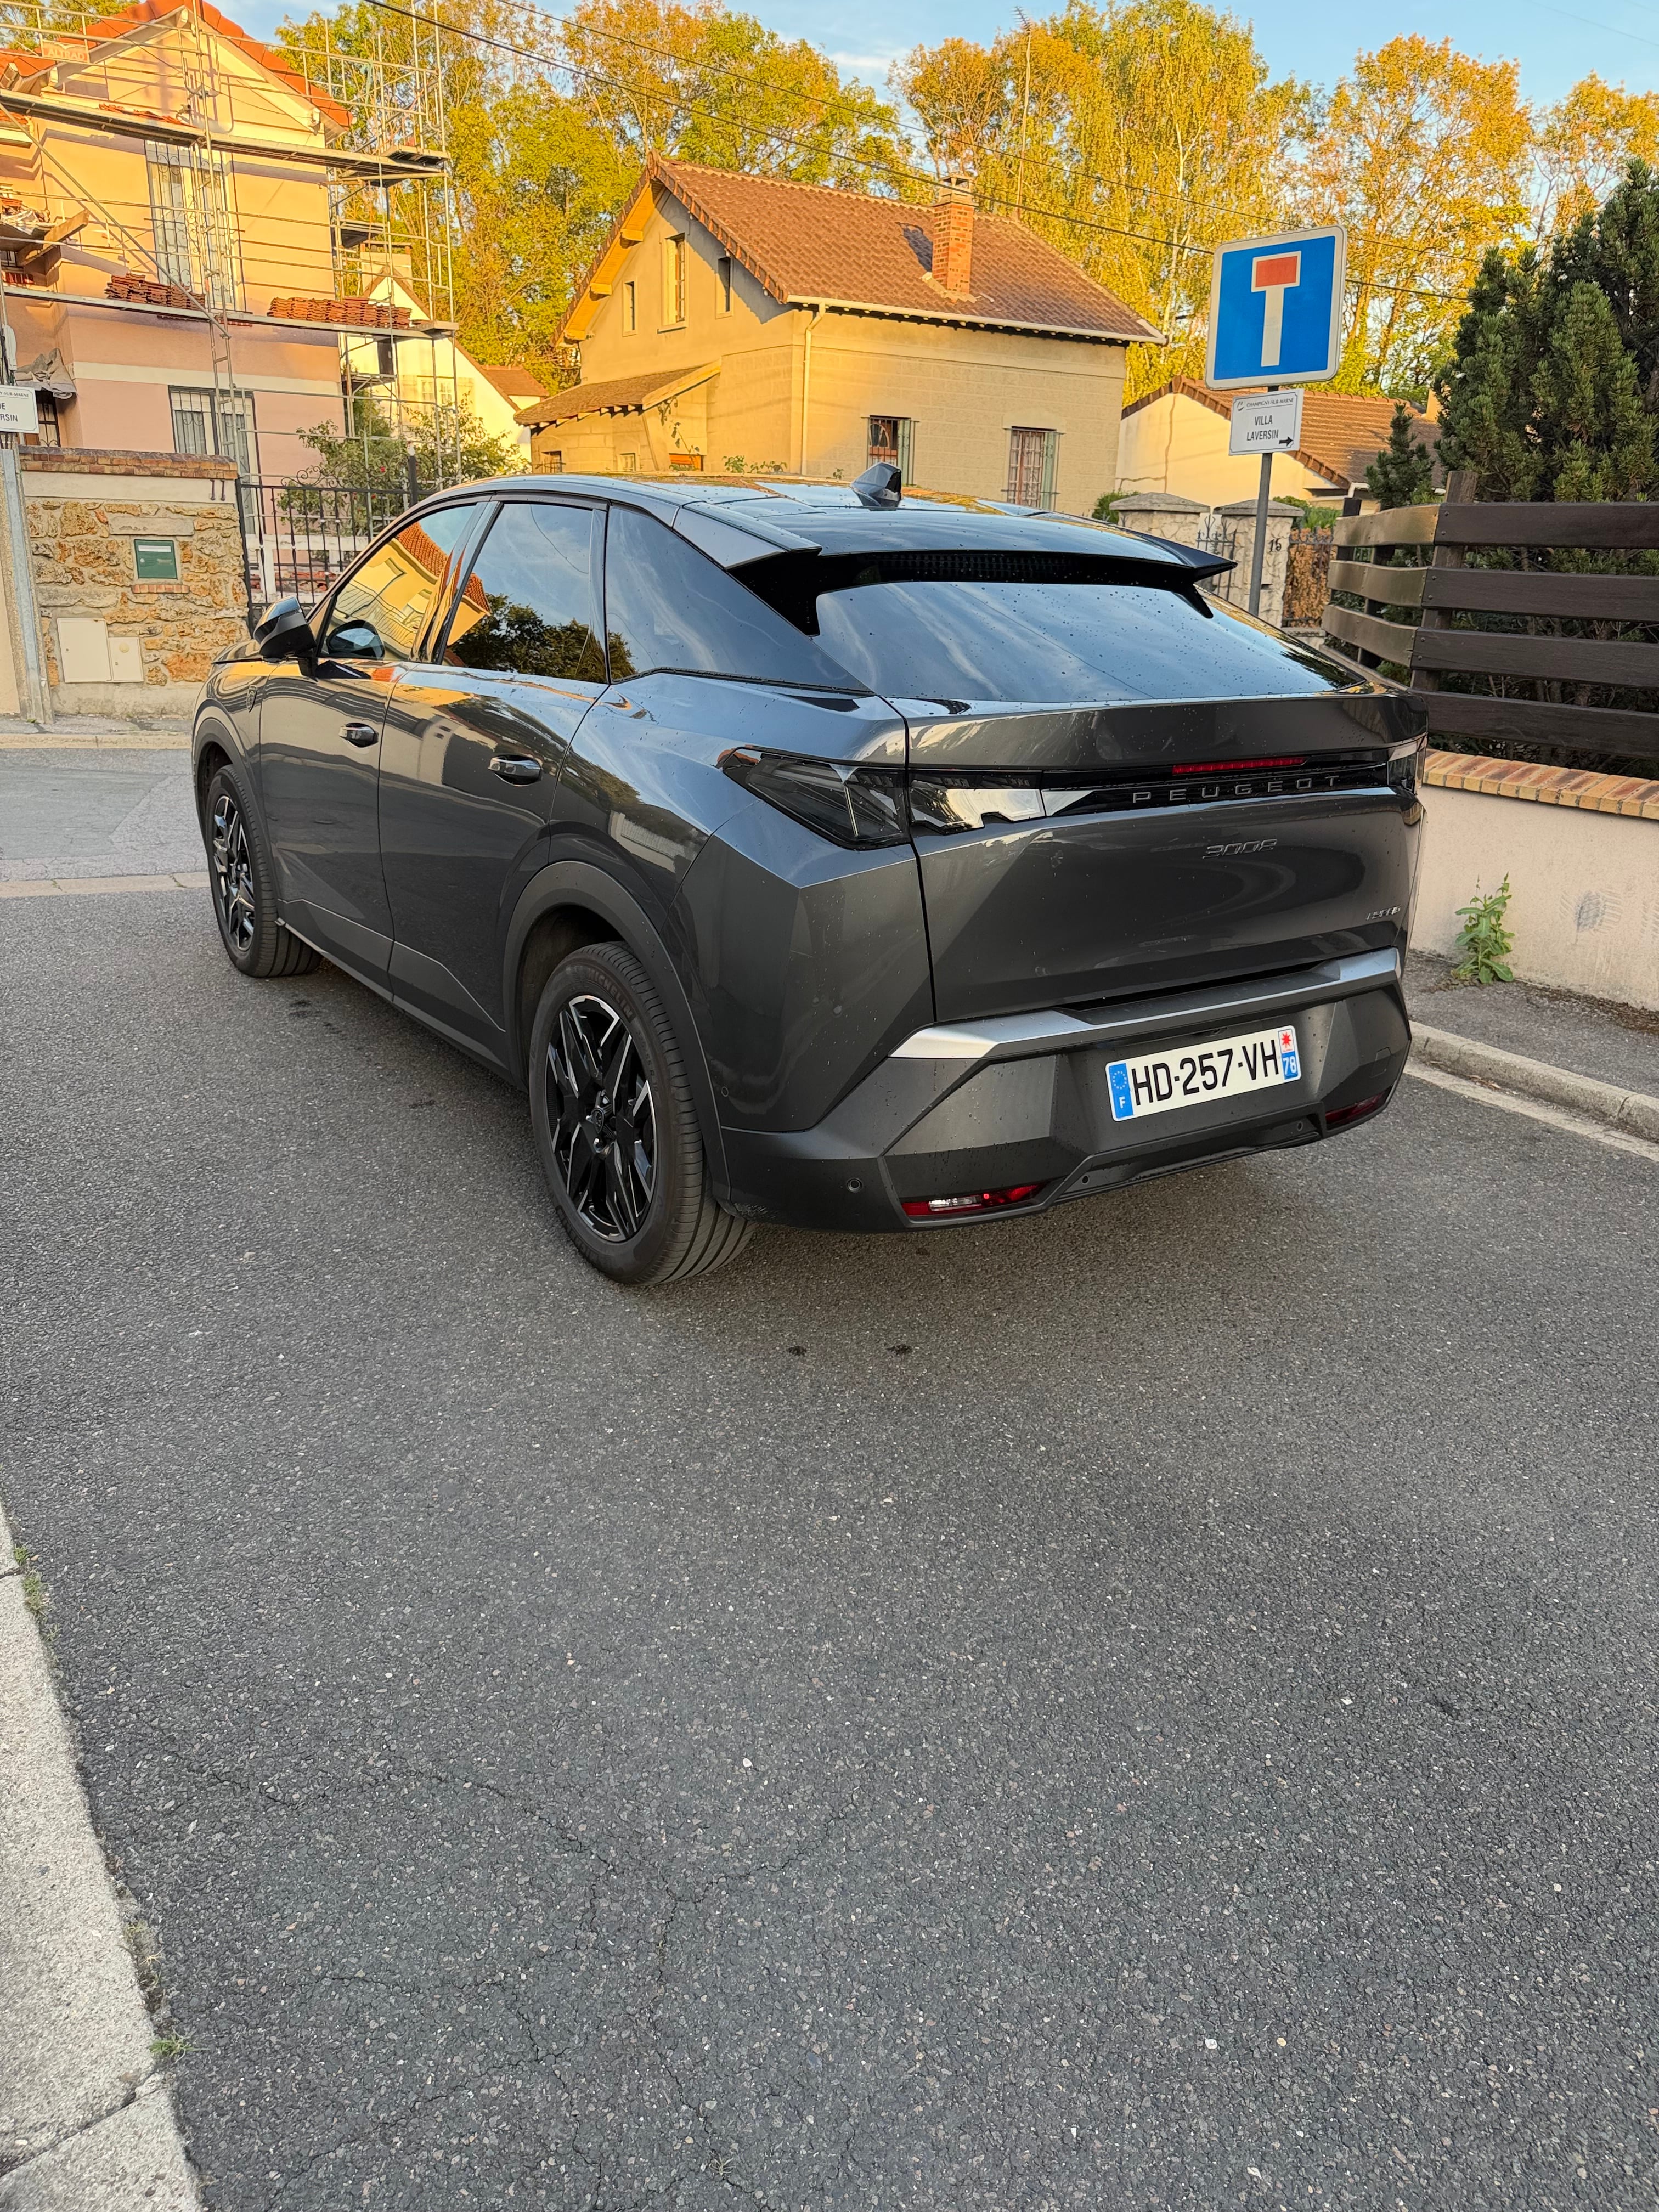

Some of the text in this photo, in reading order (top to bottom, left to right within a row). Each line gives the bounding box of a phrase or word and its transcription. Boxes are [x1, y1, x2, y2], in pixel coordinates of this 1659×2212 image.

[47, 48, 84, 60] ALTRAD
[1246, 397, 1294, 408] CHAMPIGNY-SUR-MARNE
[1254, 415, 1273, 426] VILLA
[1246, 429, 1279, 441] LAVERSIN
[1132, 775, 1340, 804] PEUGEOT
[1201, 838, 1278, 860] 3008
[586, 967, 634, 1019] MICHELIN
[1131, 1039, 1279, 1106] HD-257-VH
[1283, 1056, 1297, 1076] 78
[1119, 1096, 1126, 1109] F
